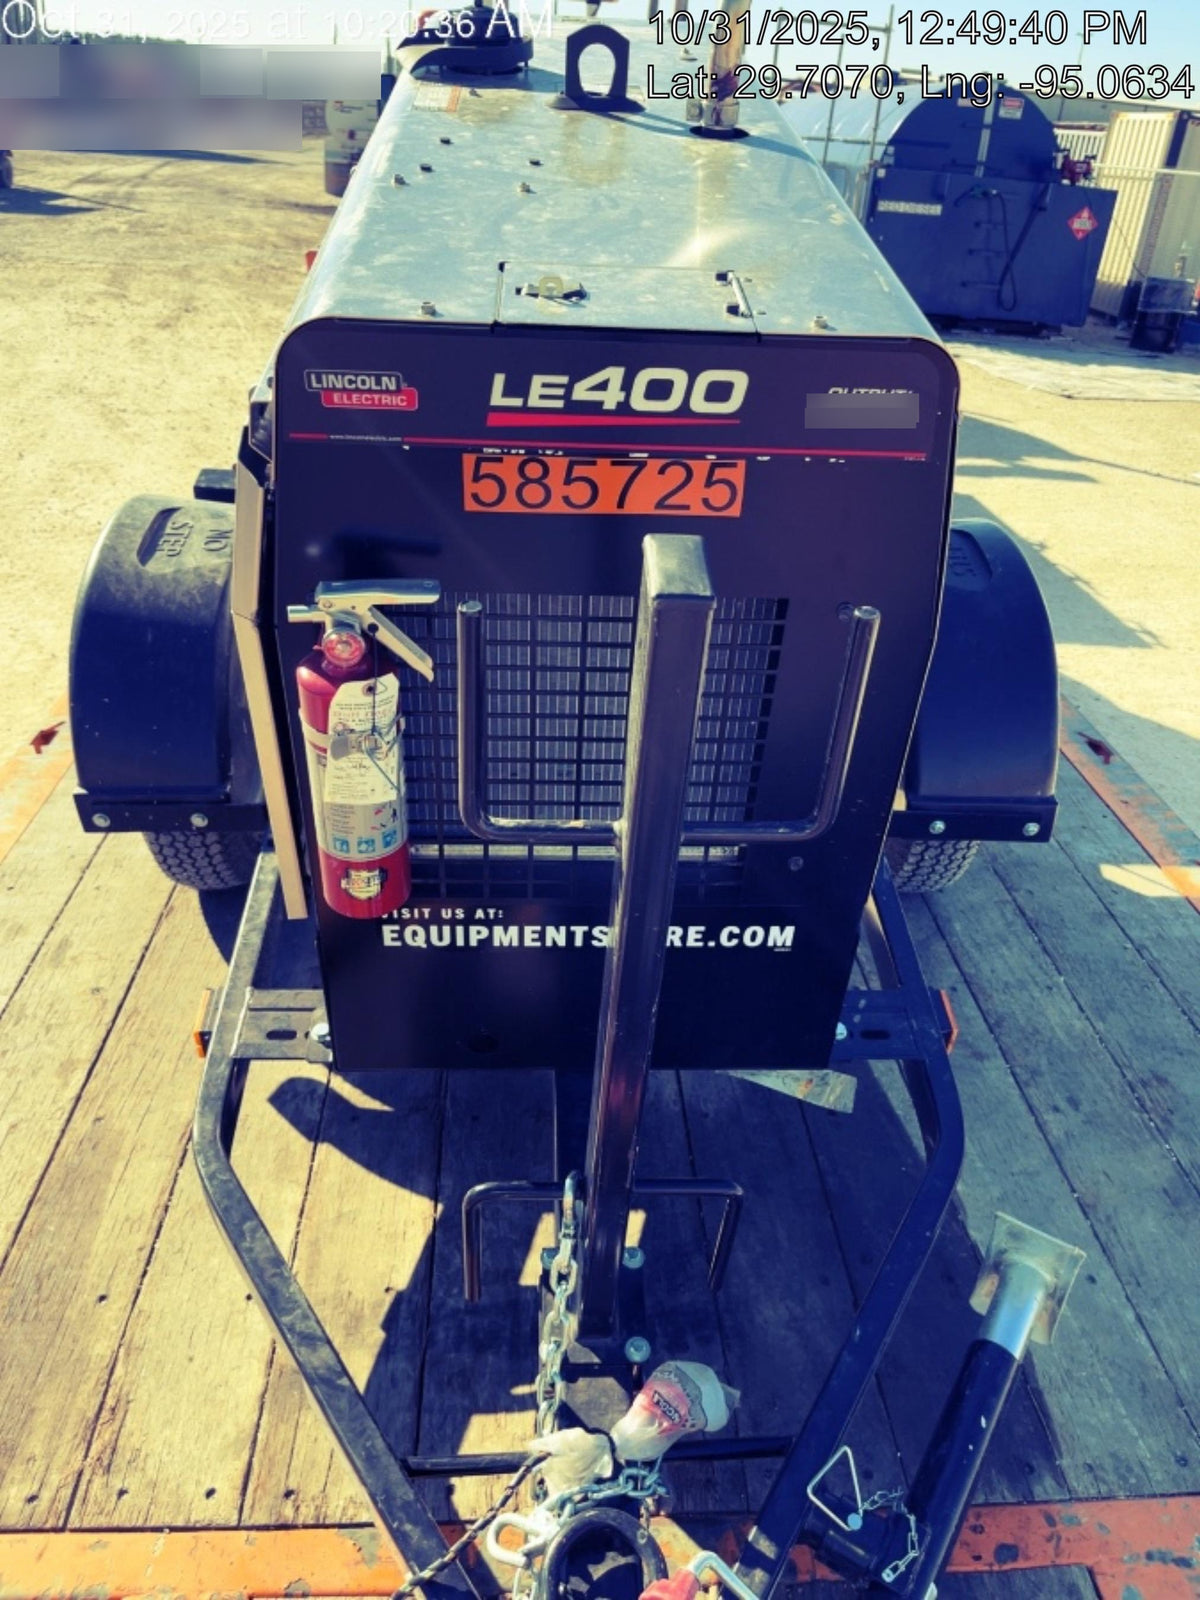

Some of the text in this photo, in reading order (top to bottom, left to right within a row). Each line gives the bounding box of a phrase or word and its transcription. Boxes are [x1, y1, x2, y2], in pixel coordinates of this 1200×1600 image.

[310, 373, 397, 391] LINCOLN
[490, 365, 749, 414] LE400
[333, 393, 408, 407] ELECTRIC
[470, 456, 738, 513] 585725
[381, 907, 503, 919] ISIT US AT:
[381, 924, 796, 949] EQUIPMENTSRE.COM
